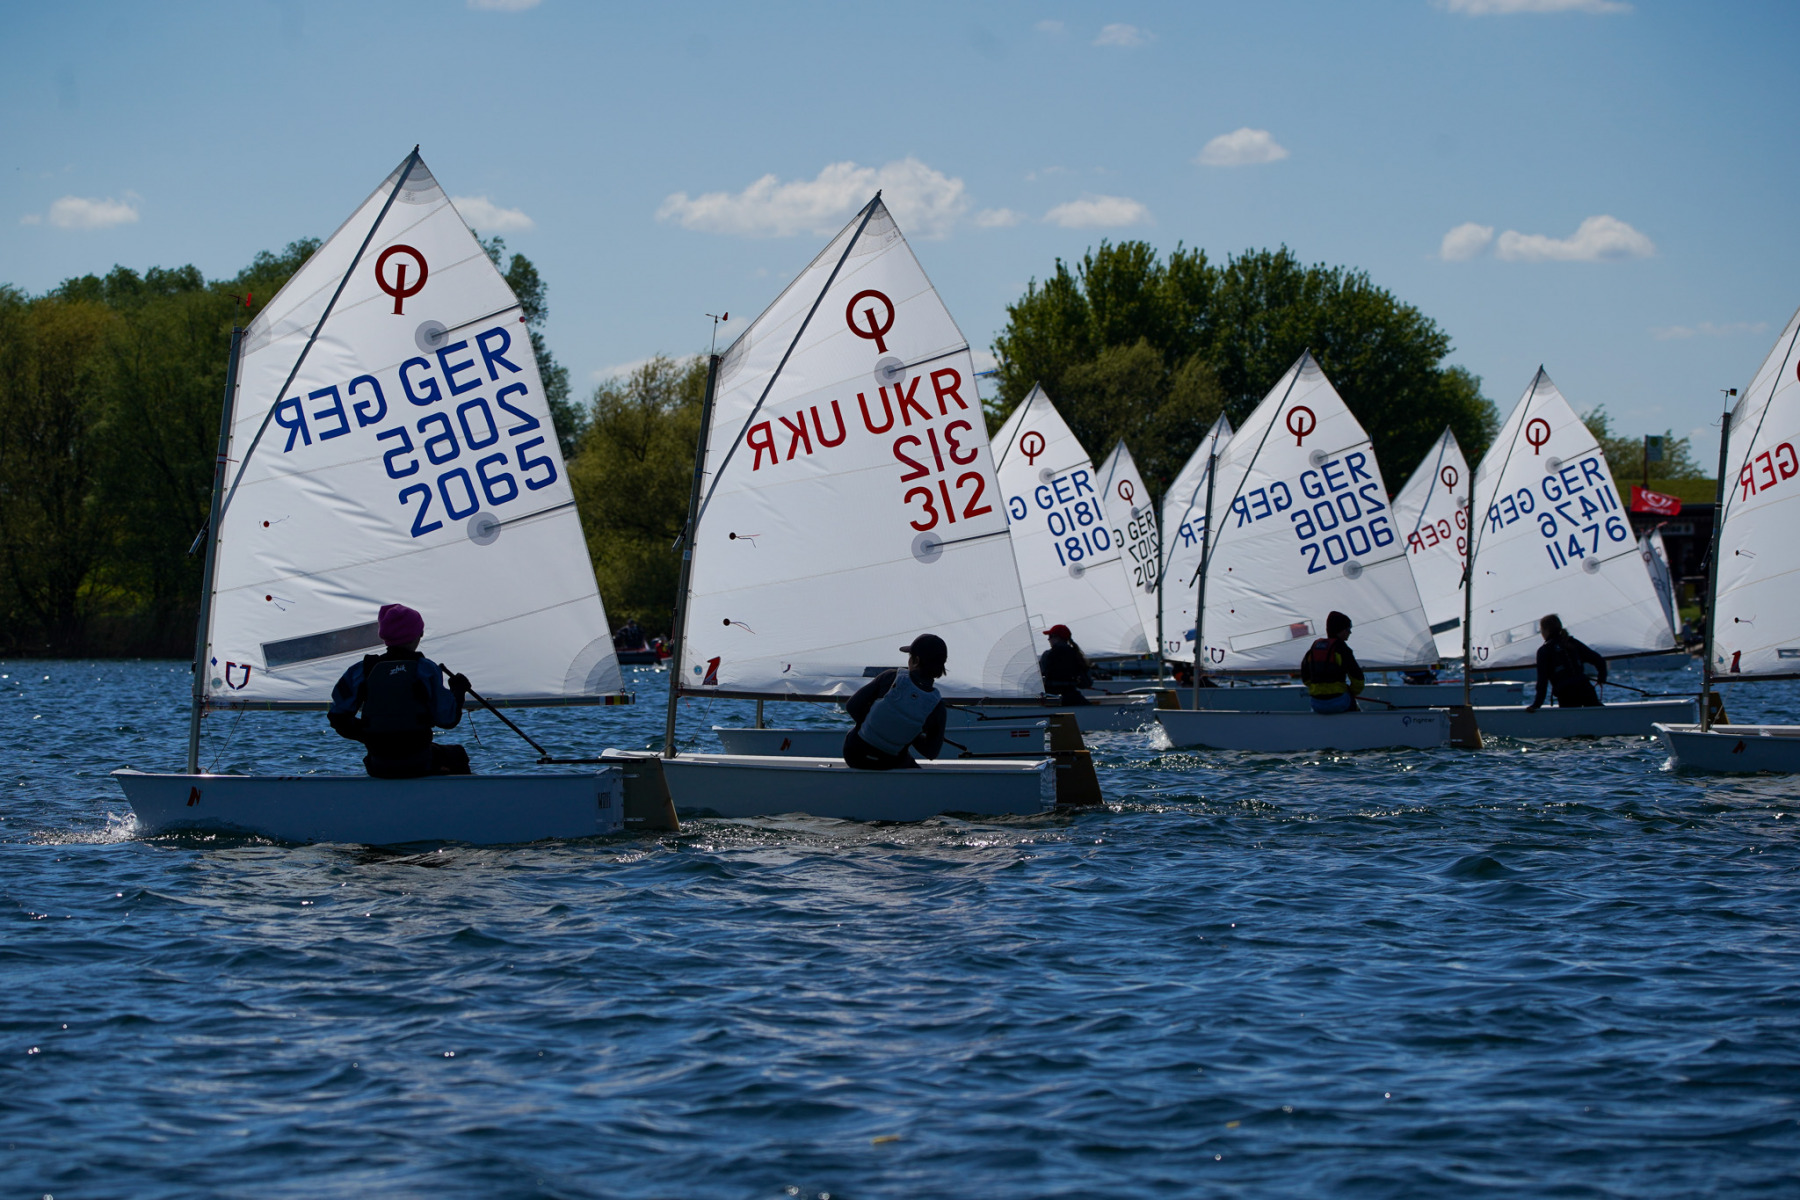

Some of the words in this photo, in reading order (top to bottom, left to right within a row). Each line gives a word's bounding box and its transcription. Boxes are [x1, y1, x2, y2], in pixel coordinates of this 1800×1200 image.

[399, 326, 522, 406] GER
[856, 367, 969, 435] UKR
[398, 435, 558, 538] 2065
[903, 471, 993, 532] 312
[1034, 469, 1095, 510] GER
[1300, 451, 1373, 499] GER
[1542, 457, 1606, 502] GER
[1054, 526, 1111, 567] 1810
[1128, 510, 1156, 541] GER
[1300, 515, 1395, 575] 2006
[1545, 514, 1628, 571] 11476
